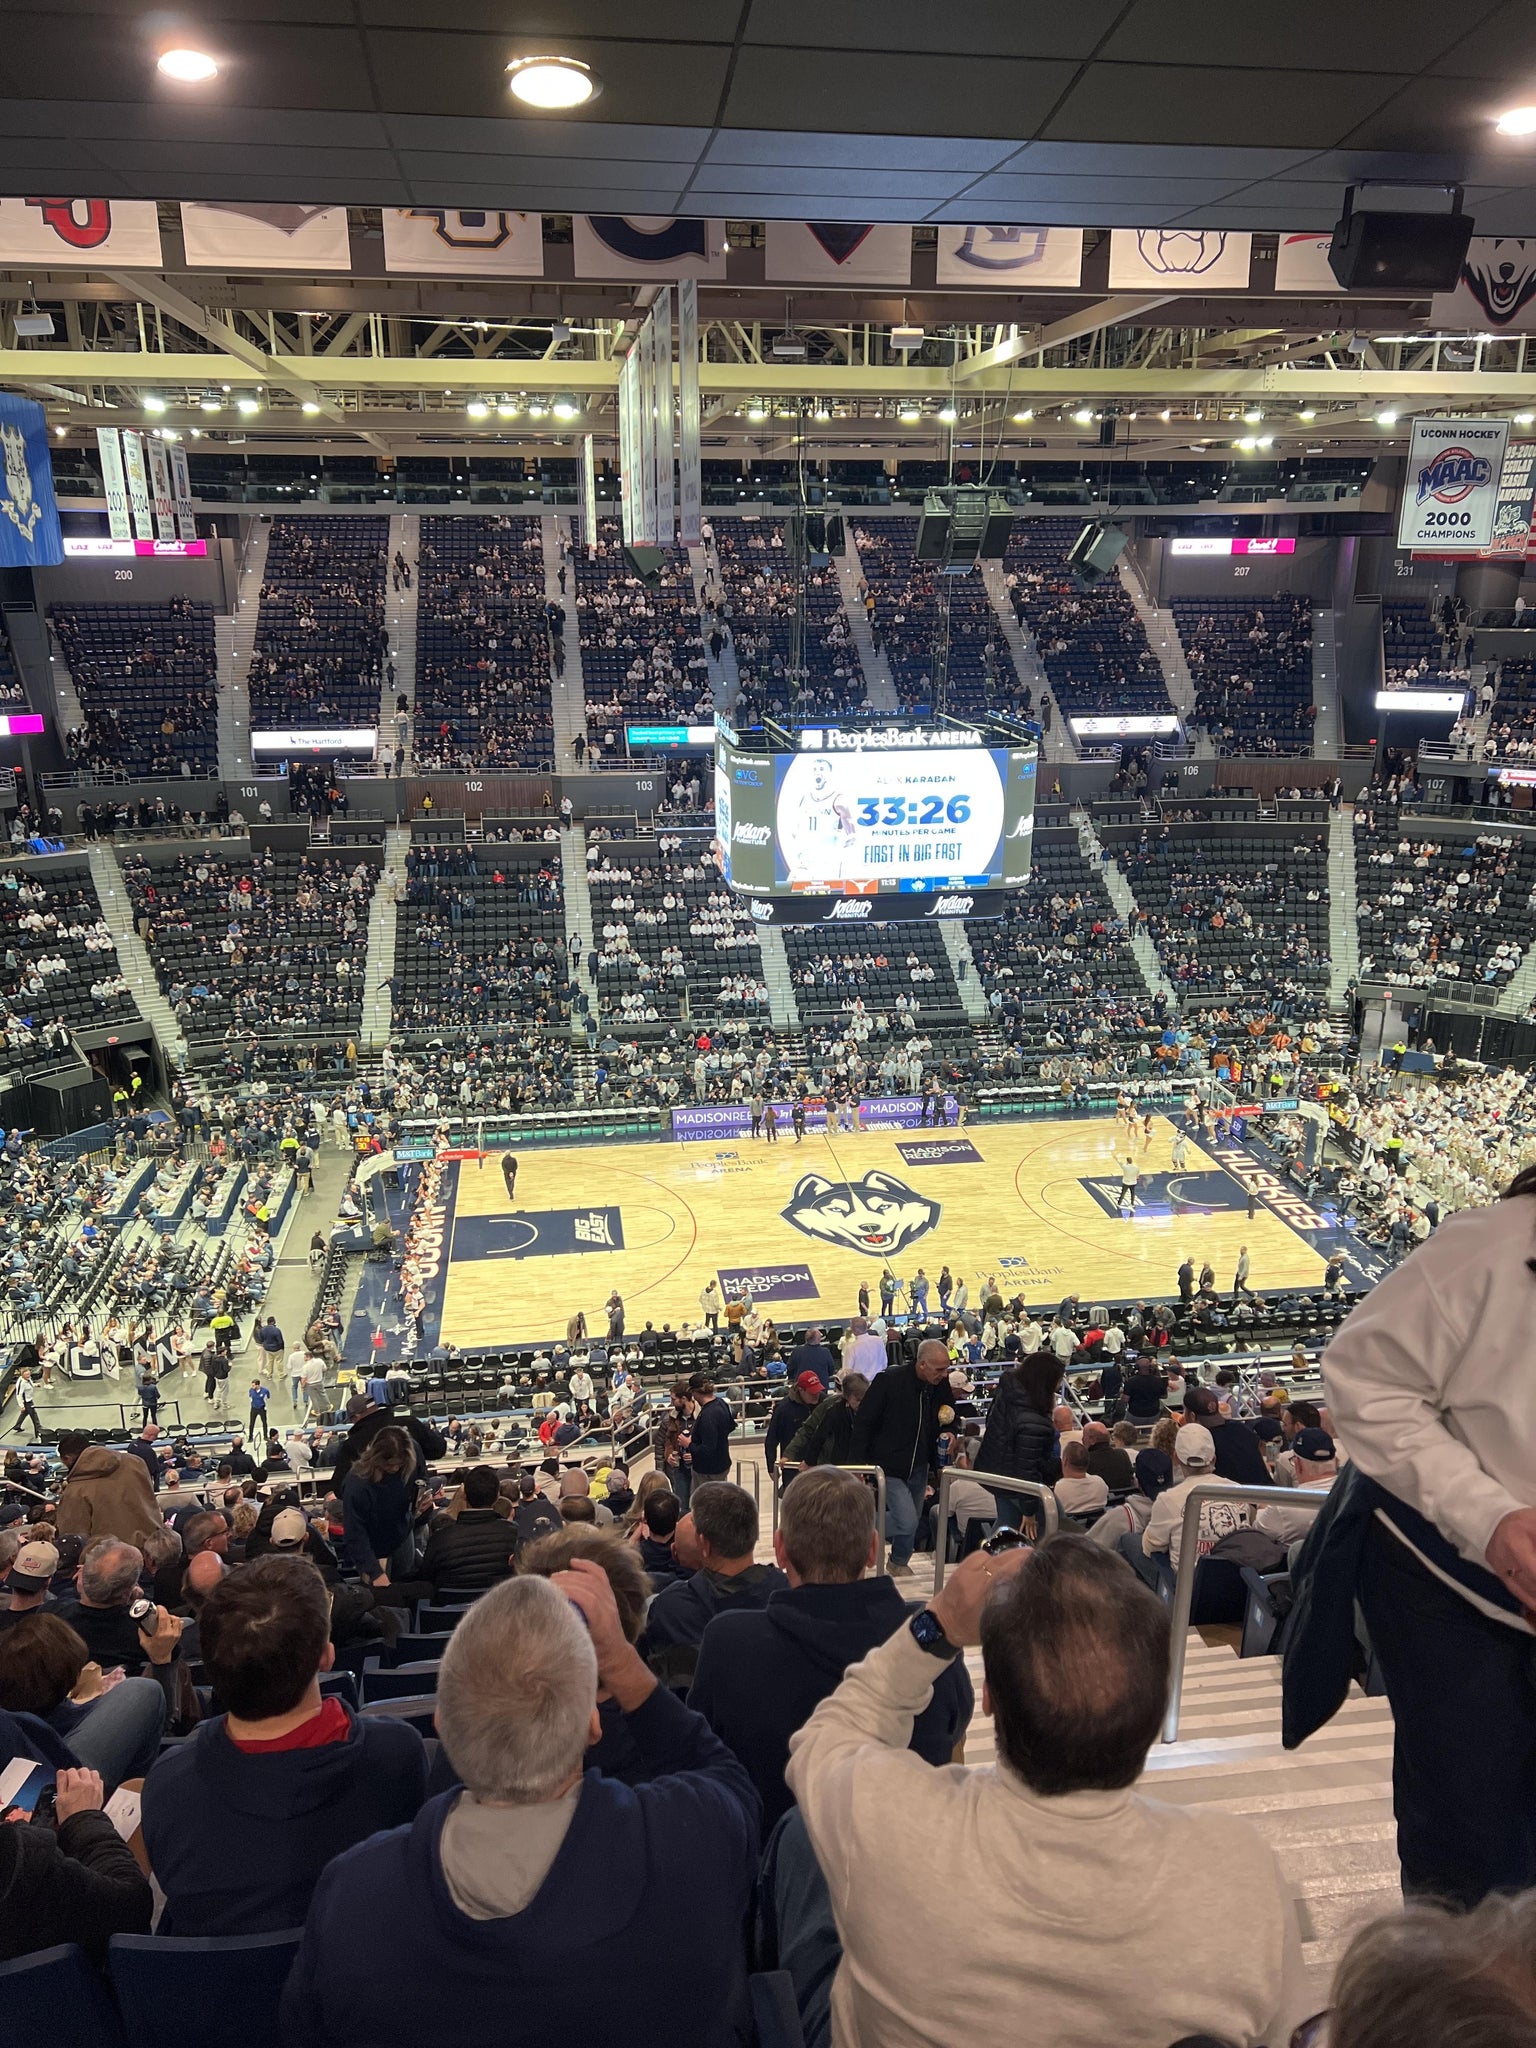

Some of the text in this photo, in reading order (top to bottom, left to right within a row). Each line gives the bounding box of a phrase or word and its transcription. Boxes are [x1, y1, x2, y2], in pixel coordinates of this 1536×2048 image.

[1420, 429, 1501, 439] UCONN HOCKEY
[1417, 457, 1492, 506] MAAC
[1425, 511, 1471, 526] 2000
[1417, 529, 1476, 539] CHAMPIONS
[114, 570, 133, 580] 200
[1234, 566, 1250, 576] 207
[1397, 566, 1414, 576] 231
[827, 727, 983, 752] PeoplesBank ARENA
[1183, 765, 1199, 776] 106
[905, 775, 956, 784] KARABAN
[1427, 779, 1446, 790] 107
[464, 781, 483, 792] 102
[635, 780, 653, 791] 103
[240, 786, 258, 797] 101
[857, 794, 972, 827] 33:26
[731, 821, 772, 841] Jordan's
[871, 829, 910, 837] MINUTES
[864, 844, 894, 864] FIRST
[898, 844, 910, 862] IN
[913, 843, 932, 862] BIG
[822, 898, 873, 919] Jordan's
[924, 894, 975, 915] Jordan's
[901, 1144, 973, 1155] MADISON
[690, 1158, 768, 1169] PeoplesBank
[1213, 1149, 1331, 1231] HUSKIES
[574, 1218, 591, 1242] BIG
[589, 1212, 606, 1244] EAST
[975, 1265, 1065, 1279] PeoplesBank
[723, 1272, 810, 1287] MADISON
[1004, 1278, 1054, 1287] ARENA
[724, 1283, 771, 1295] REED
